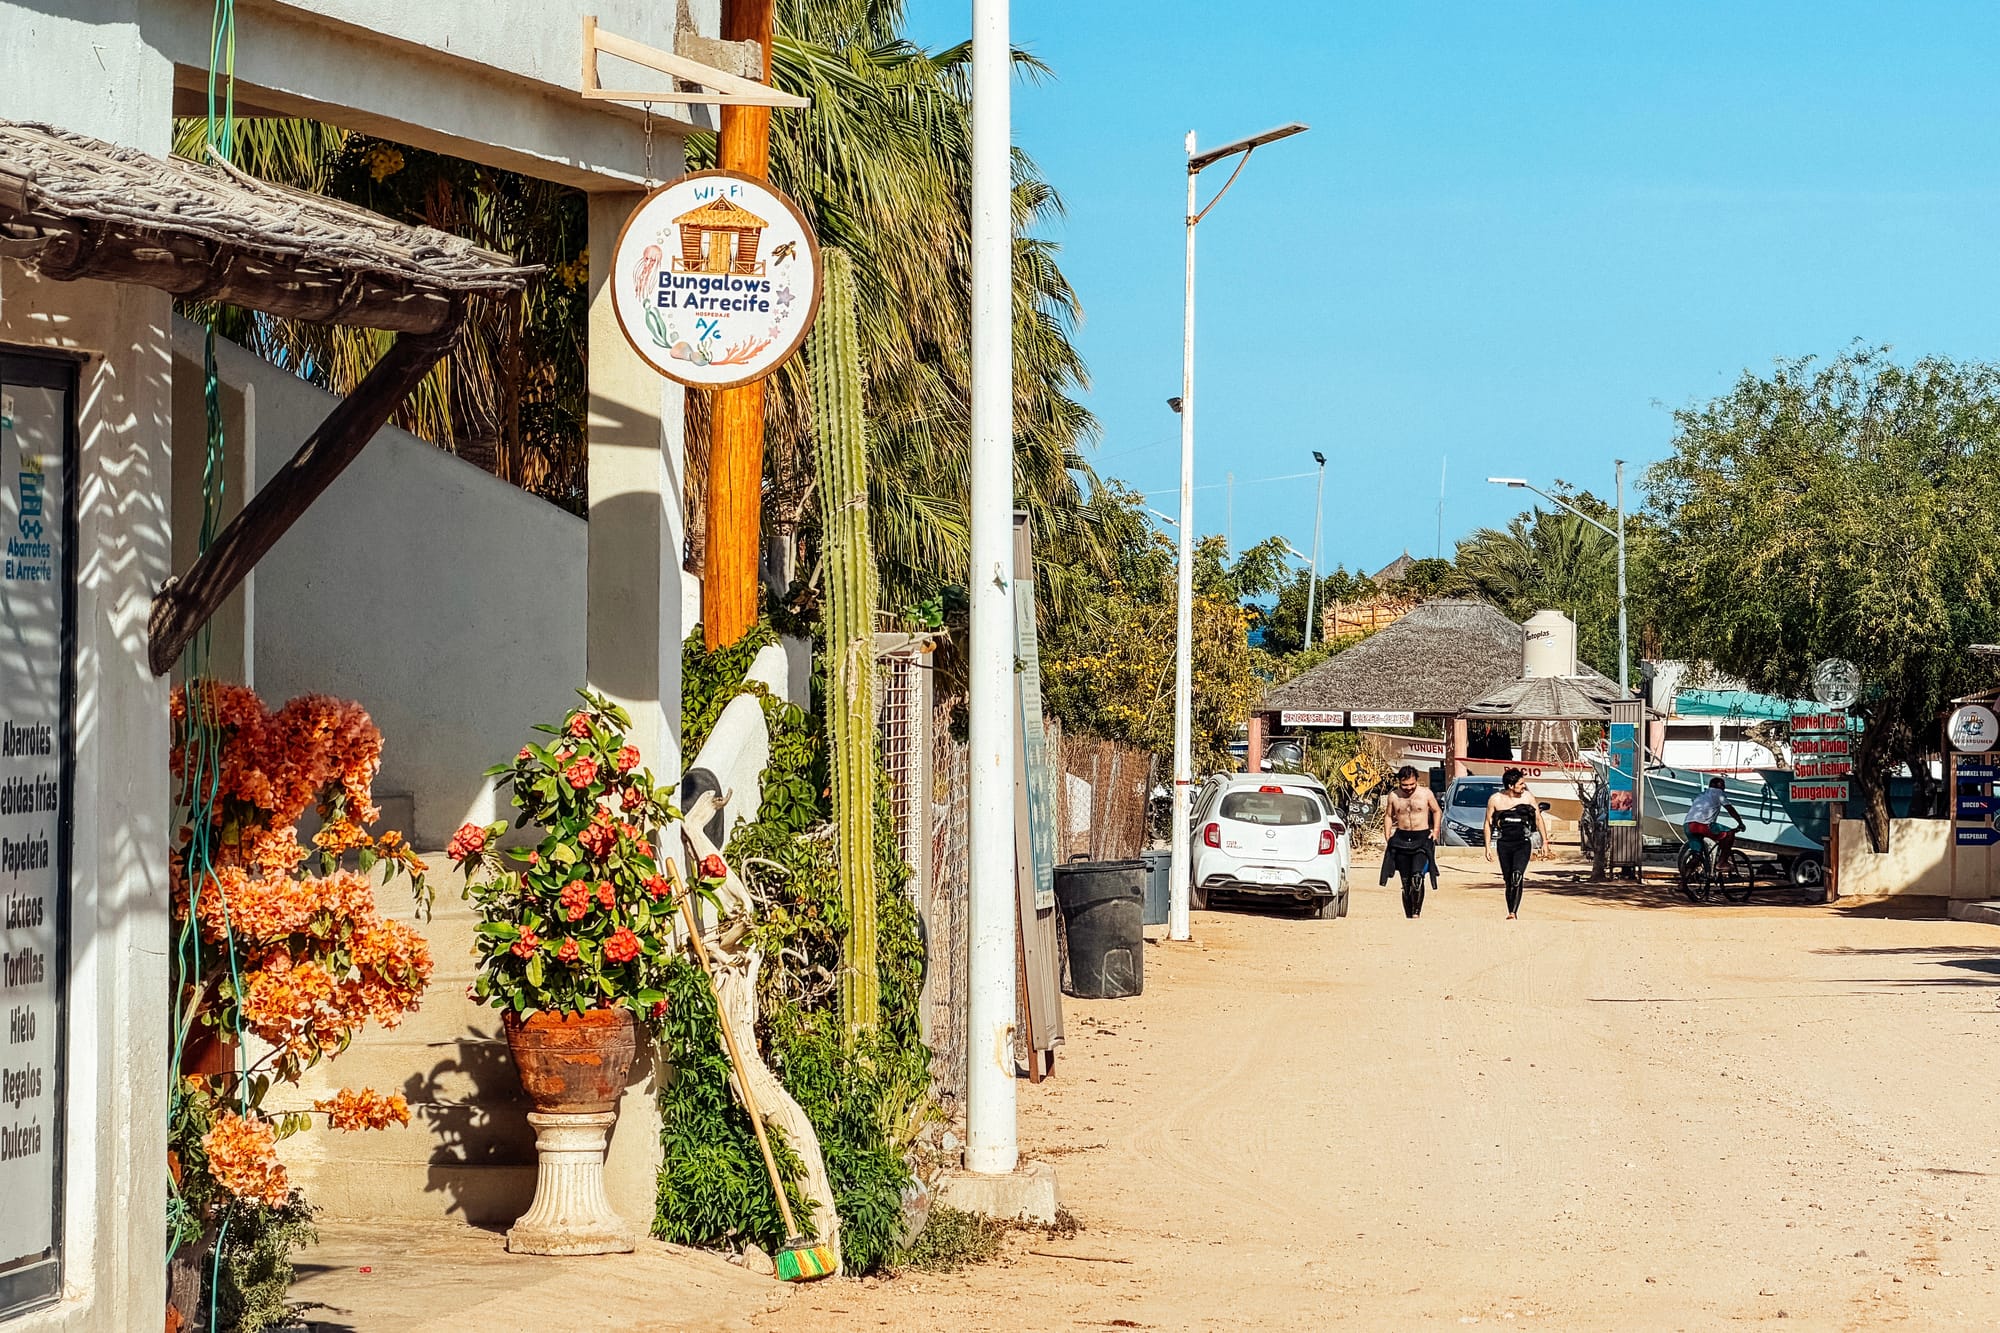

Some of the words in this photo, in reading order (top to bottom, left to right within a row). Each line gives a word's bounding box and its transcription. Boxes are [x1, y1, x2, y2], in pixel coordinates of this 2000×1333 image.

[658, 271, 771, 295] Bungalows
[657, 291, 677, 308] El
[683, 292, 770, 312] Arrecife
[7, 536, 50, 559] Abarrotes
[6, 560, 14, 580] El
[16, 559, 51, 580] Arrecife
[1791, 713, 1820, 731] Snorkel
[1821, 713, 1846, 729] Tour's
[2, 719, 51, 757] Abarrotes
[1408, 742, 1444, 754] YUNUEN
[1791, 739, 1818, 754] Scuba
[1821, 739, 1848, 754] Diving
[1795, 763, 1819, 778] Sport
[0, 775, 34, 816] ebidas
[36, 771, 57, 811] frías
[1791, 784, 1846, 800] Bungalow's
[2, 828, 49, 880] Papelería
[5, 888, 43, 930] Lácteos
[3, 947, 44, 989] Tortillas
[10, 1004, 36, 1044] Hielo
[2, 1062, 41, 1109] Regalos
[1, 1114, 41, 1162] Dulcería
